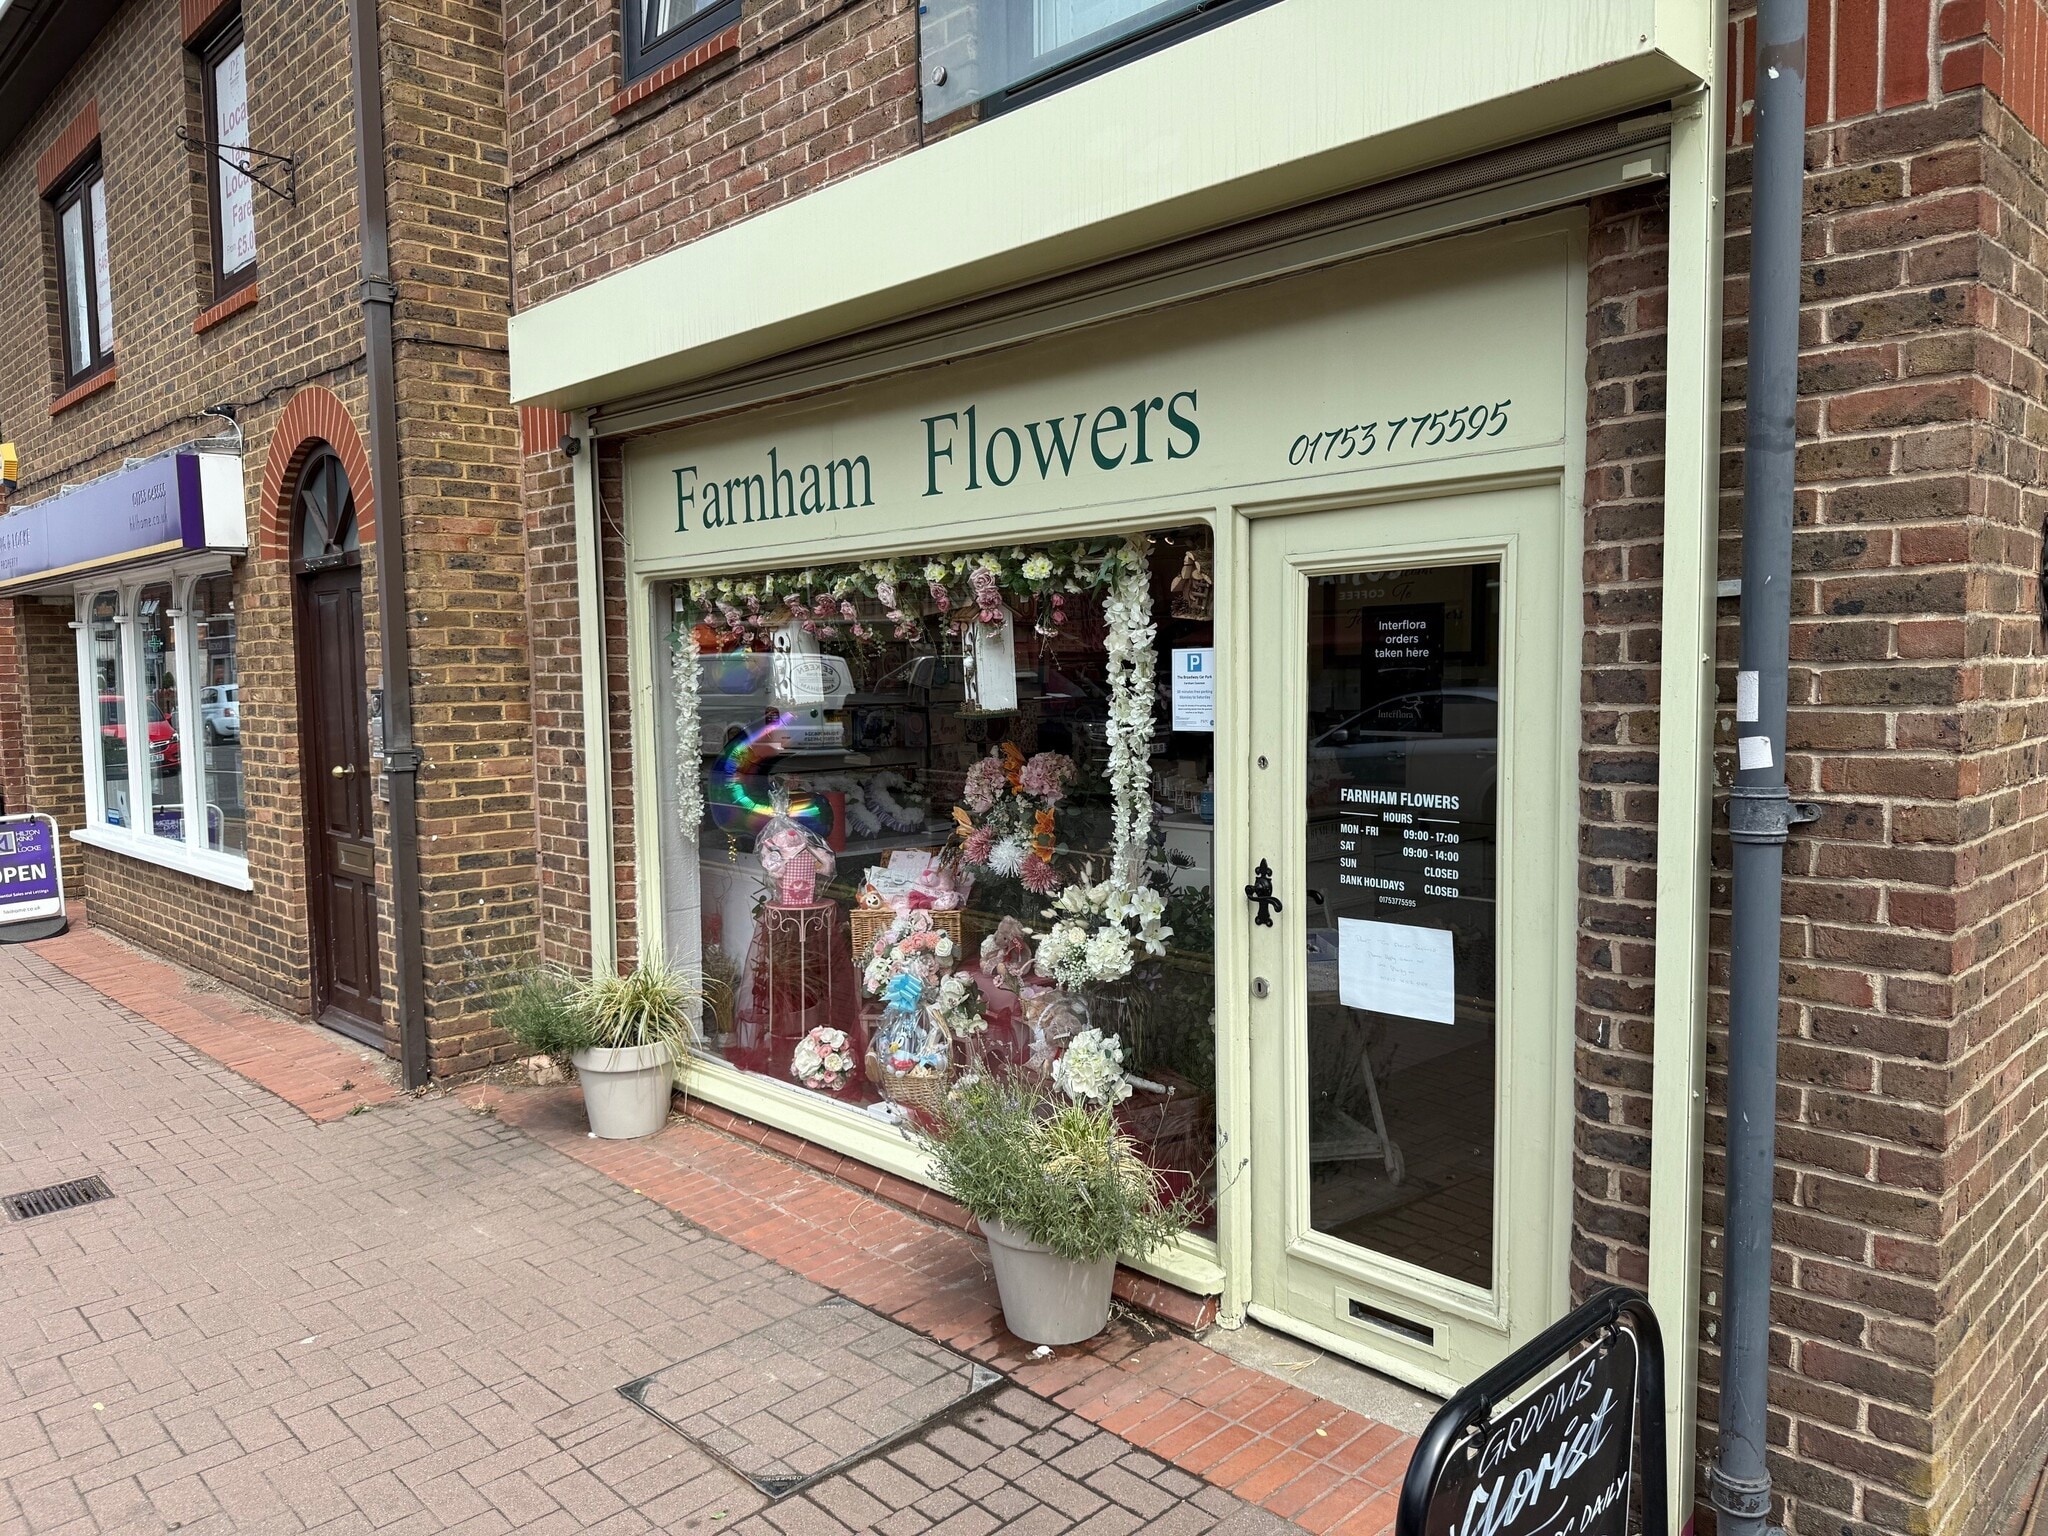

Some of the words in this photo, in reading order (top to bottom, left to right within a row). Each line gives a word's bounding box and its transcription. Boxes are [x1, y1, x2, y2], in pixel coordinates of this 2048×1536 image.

[1288, 421, 1377, 466] 01753
[1387, 399, 1512, 452] 775595
[672, 447, 875, 533] Farnham
[920, 389, 1202, 498] Flowers
[11, 528, 31, 549] LOCKE
[1378, 619, 1427, 631] Interflora
[1385, 634, 1419, 644] orders
[1375, 648, 1403, 658] taken
[1406, 647, 1430, 658] here
[1377, 709, 1414, 719] Interflora
[1340, 788, 1397, 806] FARNHAM
[1400, 792, 1460, 810] FLOWERS
[1383, 811, 1413, 824] HOURS
[15, 829, 41, 838] HILTON
[16, 835, 34, 843] KING
[1340, 823, 1359, 835] MON
[1365, 825, 1379, 837] FRI
[1403, 829, 1429, 841] 09:00
[1435, 832, 1460, 844] 17:00
[17, 844, 42, 853] LOCKE
[1340, 840, 1355, 851] SAT
[1402, 846, 1428, 859] 09:00
[1435, 850, 1459, 862] 14:00
[0, 862, 47, 884] PEN
[1340, 857, 1357, 869] SUN
[1424, 866, 1459, 880] CLOSED
[1340, 874, 1363, 886] BANK
[1364, 877, 1405, 891] HOLIDAYS
[1424, 884, 1459, 898] CLOSED
[1378, 895, 1417, 908] 01753775595
[1478, 1359, 1596, 1479] GROOMS
[1579, 1470, 1628, 1534] DAILY
